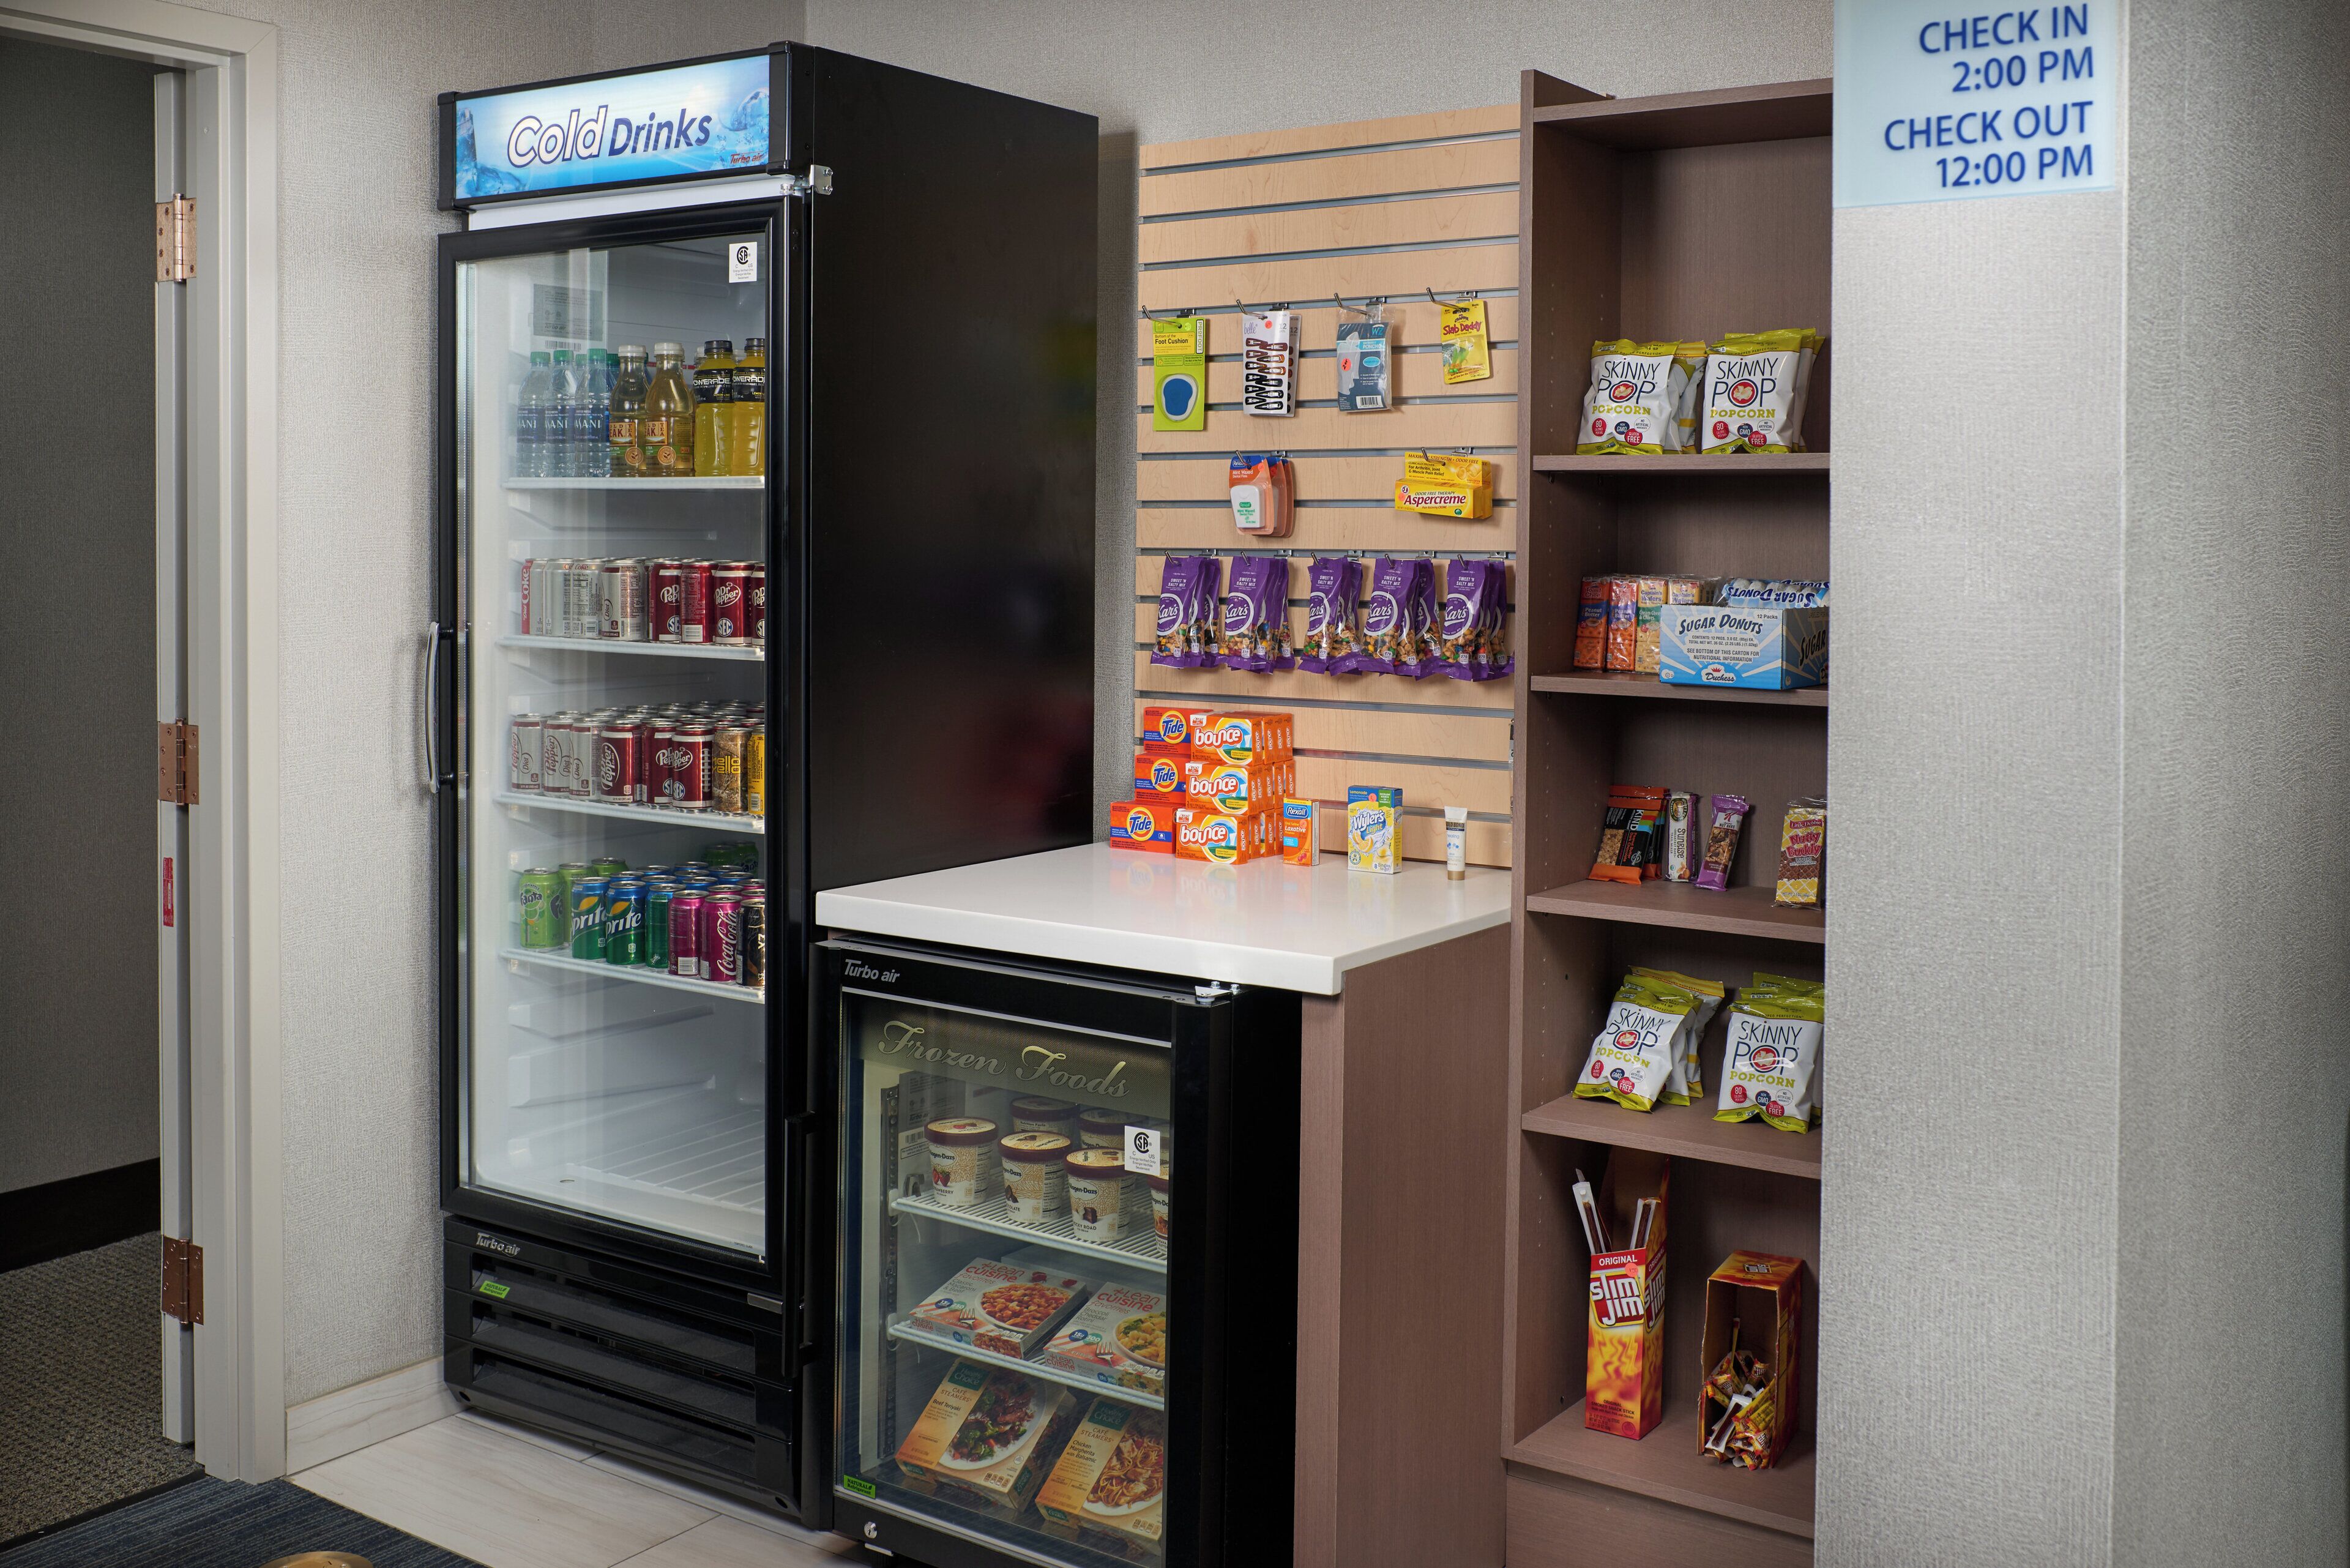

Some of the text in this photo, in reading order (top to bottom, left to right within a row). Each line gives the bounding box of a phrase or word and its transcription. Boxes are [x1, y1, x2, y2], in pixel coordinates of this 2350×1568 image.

[1919, 3, 2087, 54] CHECK IN
[1952, 46, 2094, 92] 2:00 PM
[1884, 100, 2094, 151] CHECK OUT
[507, 105, 712, 168] Cold Drinks
[730, 153, 750, 165] Turbo
[1936, 144, 2093, 187] 12:00 PM
[1244, 322, 1256, 334] belle
[1443, 324, 1459, 335] Slab
[1460, 321, 1482, 332] Daddy
[1602, 357, 1661, 380] SKINNY
[1716, 357, 1778, 379] SKINNY
[1594, 378, 1656, 405] POP
[1712, 378, 1777, 408] POP
[1592, 404, 1651, 416] POPCORN
[1710, 409, 1776, 418] POPCORN
[1716, 422, 1724, 431] 80
[1404, 495, 1466, 507] Aspercreme
[715, 588, 738, 605] Pepper
[1728, 586, 1815, 608] DONUTS SUGAR
[1158, 603, 1178, 618] Kar's
[718, 620, 732, 634] SEC
[1679, 614, 1763, 635] SUGAR DONUTS
[1705, 673, 1736, 682] Duchess
[1162, 719, 1184, 737] Tide
[1195, 728, 1242, 748] bounce
[1153, 767, 1176, 786] Tide
[1190, 776, 1237, 796] bounce
[1128, 815, 1152, 835] Tide
[1353, 809, 1385, 832] Wyler's
[1630, 809, 1644, 831] KIND
[1180, 824, 1226, 845] bounce
[1366, 823, 1383, 835] Light
[1676, 828, 1686, 859] Sunrise
[1789, 831, 1821, 845] Nutty
[1786, 845, 1821, 857] Buddy
[606, 908, 641, 938] prite
[845, 959, 900, 983] Turbo air
[1614, 1008, 1671, 1032] SKINNY
[1598, 1022, 1658, 1056] POP
[1738, 1020, 1803, 1045] SKINNY
[878, 1020, 1132, 1099] Frozen Foods
[1732, 1040, 1799, 1075] POP
[1729, 1070, 1796, 1089] POPCORN
[1619, 1083, 1632, 1092] FREE
[476, 1232, 521, 1256] Turbo air
[1599, 1255, 1638, 1266] ORIGINAL
[1648, 1247, 1665, 1272] ORIGINAL
[991, 1263, 1025, 1277] Lean
[952, 1278, 974, 1286] Classic
[955, 1272, 996, 1285] favorites
[949, 1282, 979, 1293] Macaroni
[1084, 1307, 1110, 1316] Broccoli
[1086, 1300, 1131, 1315] favorites
[1080, 1311, 1108, 1321] Cheddar
[954, 1372, 980, 1385] Choice
[940, 1389, 970, 1403] STEAMERS
[952, 1387, 967, 1395] CAFÉ
[944, 1402, 961, 1411] Teriyaki
[1094, 1411, 1121, 1425] Choice
[1080, 1430, 1112, 1443] STEAMERS
[1092, 1427, 1109, 1436] CAFÉ
[1069, 1445, 1095, 1457] Margherita
[1073, 1439, 1092, 1449] Chicken
[1075, 1453, 1097, 1463] Balsamic
[847, 1478, 868, 1489] NATURAL
[847, 1484, 871, 1495] Refrigerant
